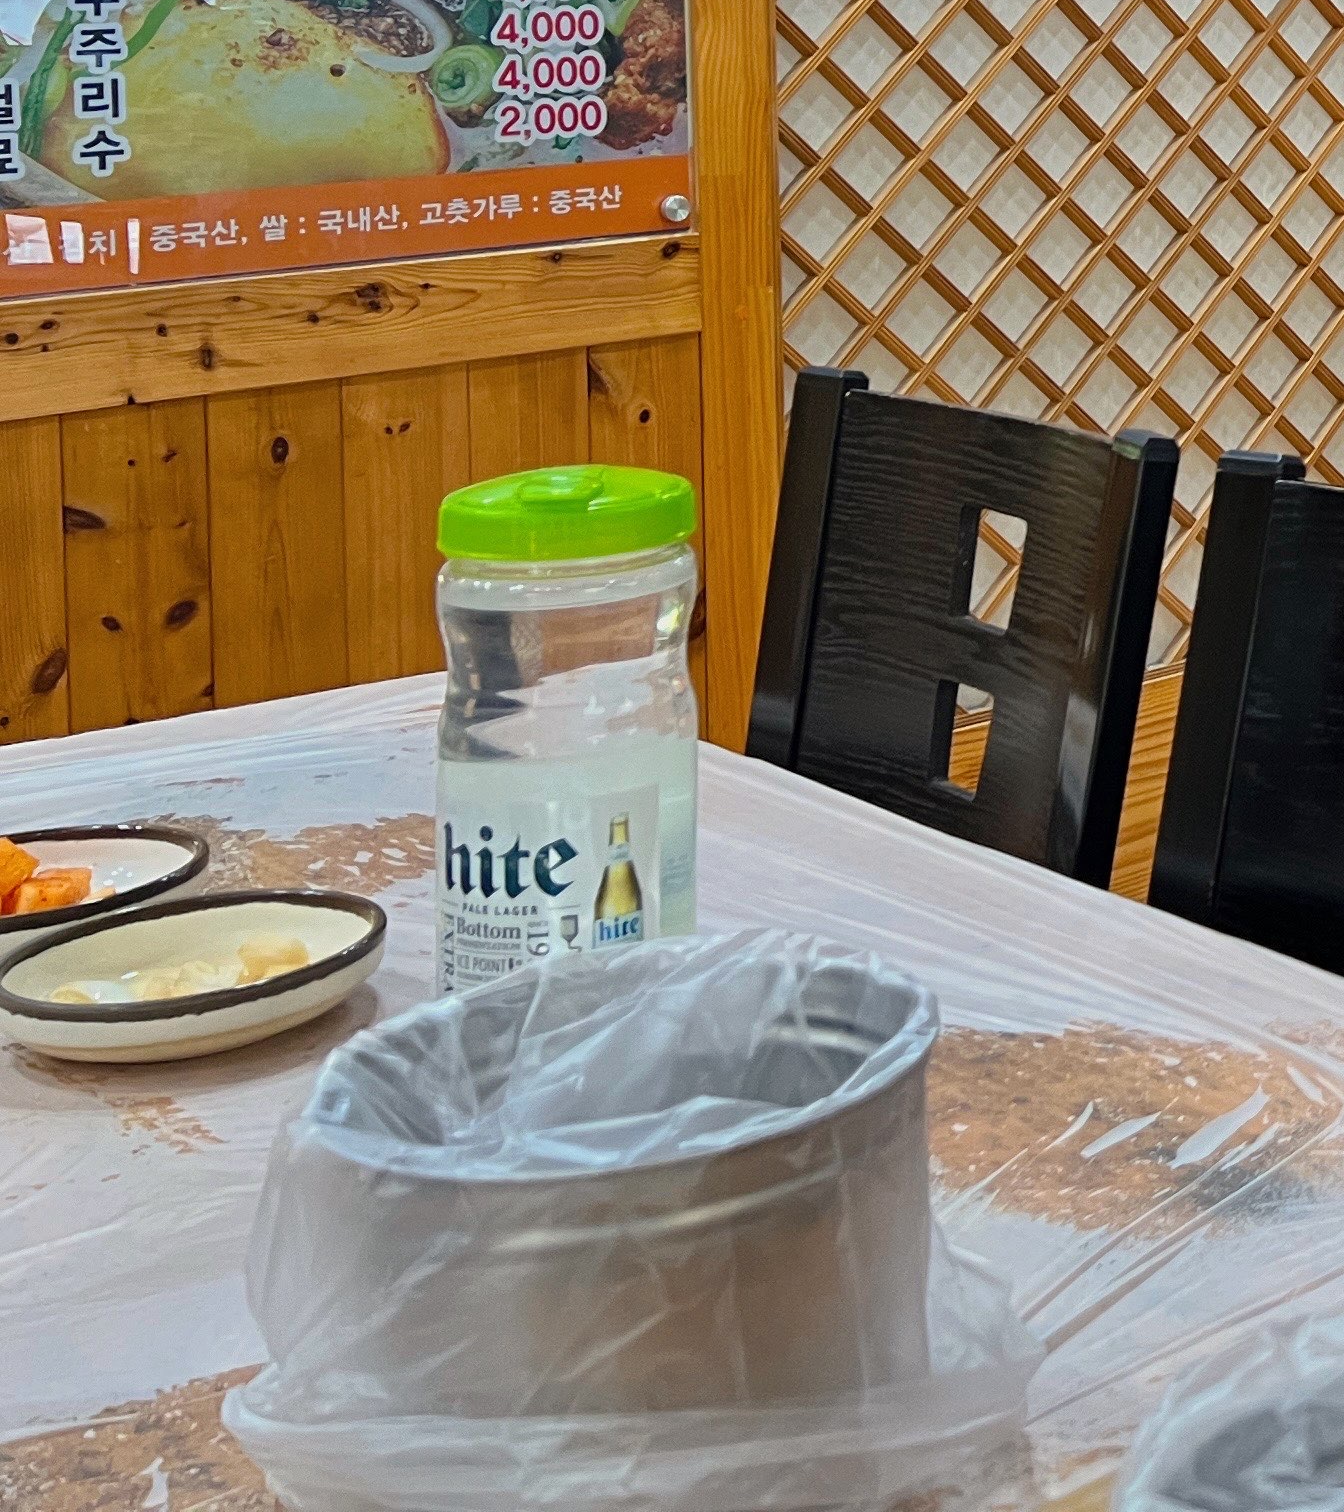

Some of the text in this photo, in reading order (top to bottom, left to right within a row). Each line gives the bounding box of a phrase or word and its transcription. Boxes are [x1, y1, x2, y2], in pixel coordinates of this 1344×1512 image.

[76, 10, 600, 68] 주 4,000
[498, 56, 600, 94] 4,000
[500, 101, 601, 139] 2,000
[259, 214, 288, 241] 쌀
[418, 194, 523, 226] 고춧가루
[549, 185, 622, 215] 중국산
[443, 821, 580, 899] hite
[456, 916, 521, 940] Bottom
[462, 902, 538, 916] PALE LAGER
[599, 916, 640, 942] hite
